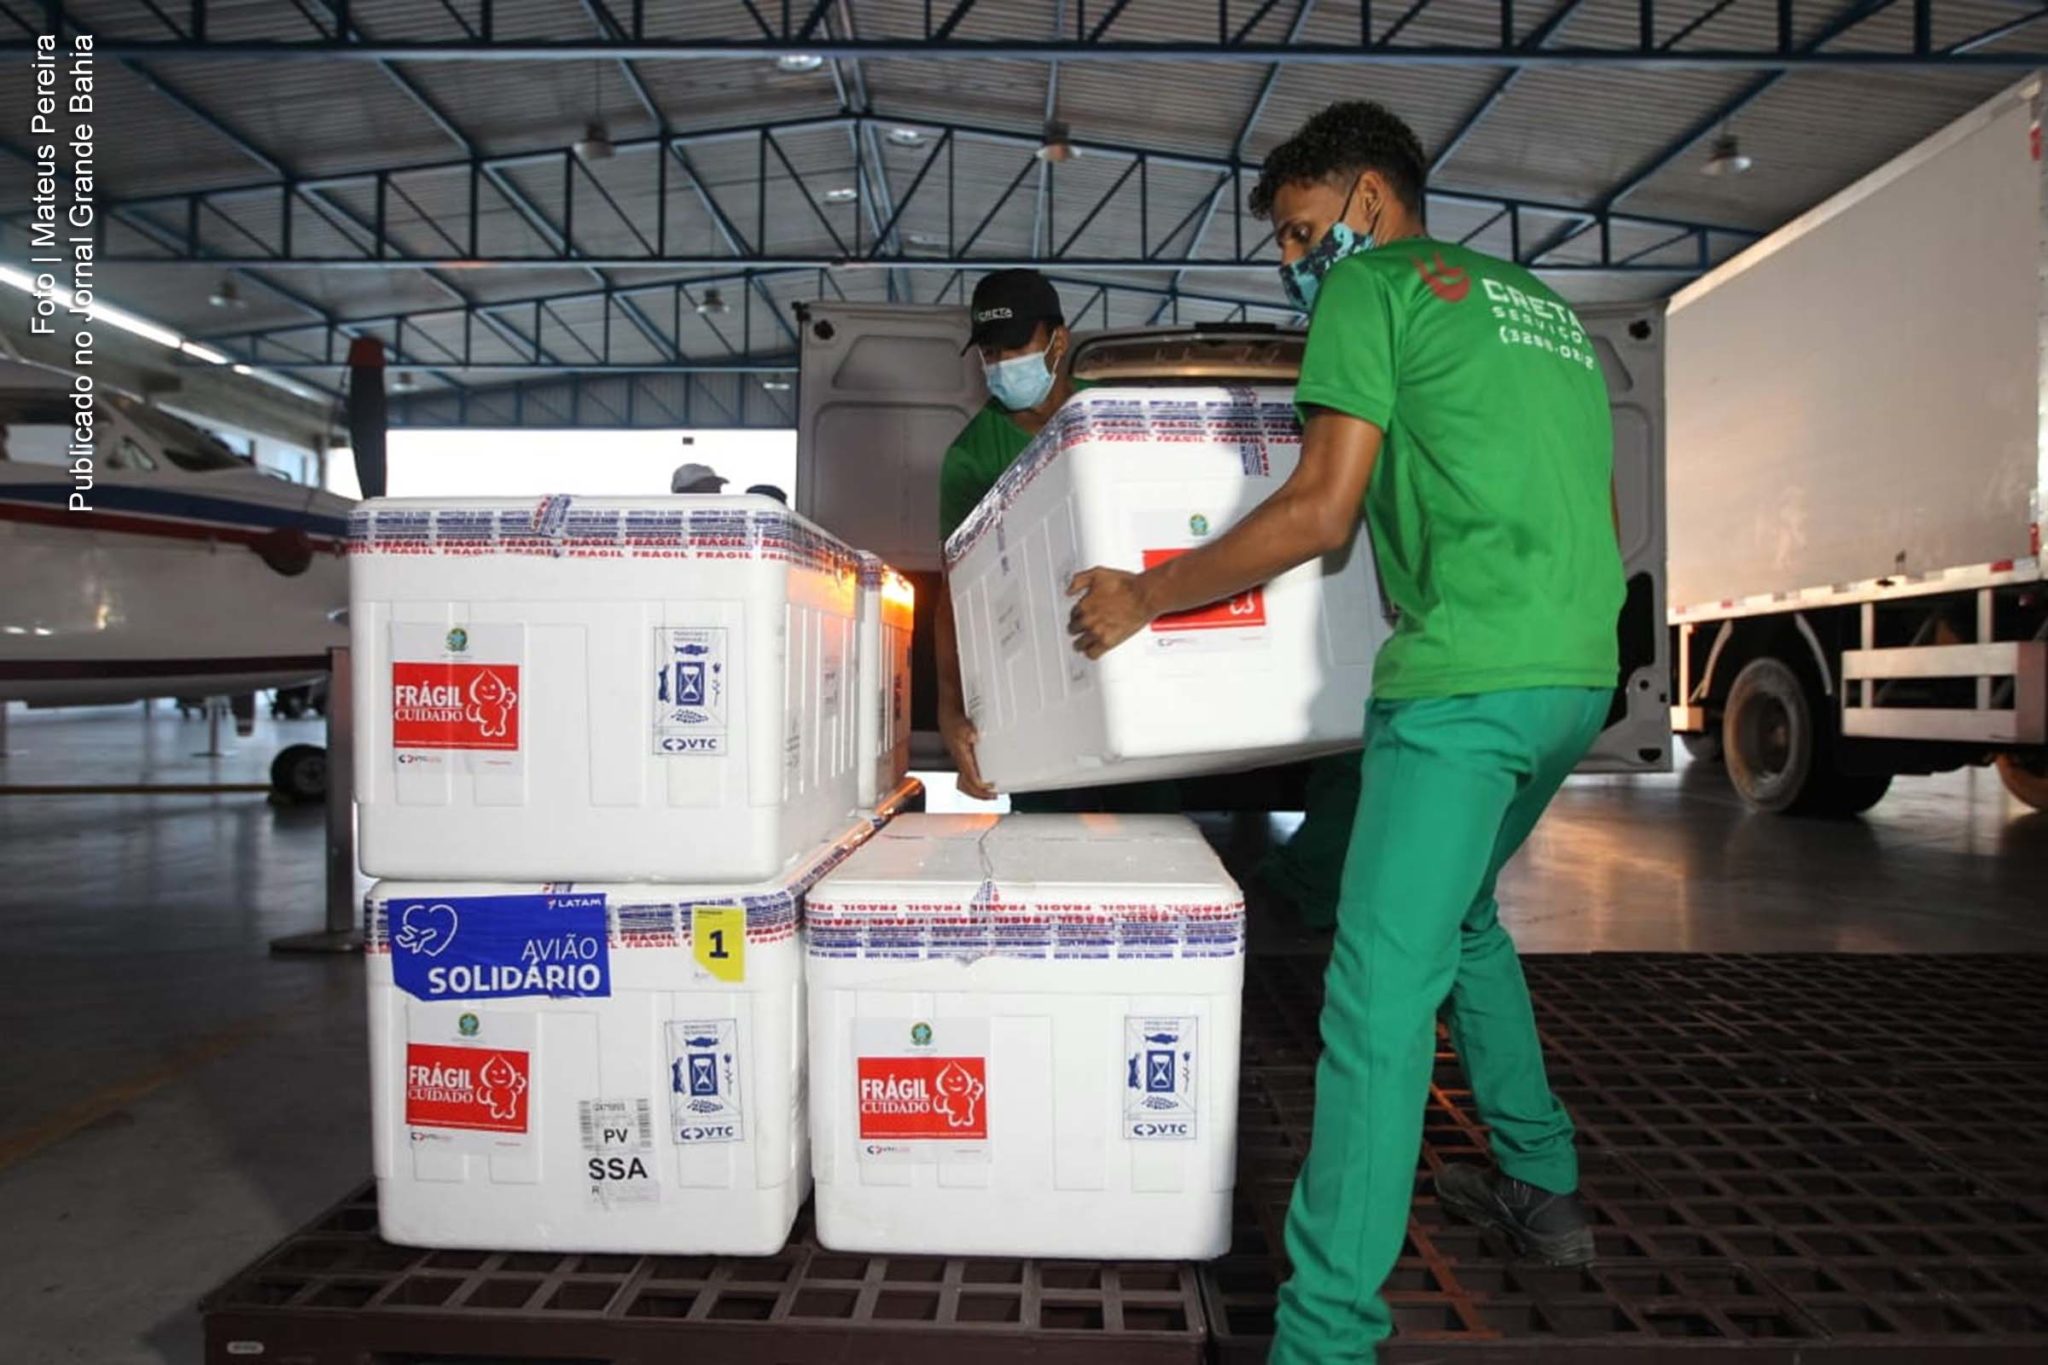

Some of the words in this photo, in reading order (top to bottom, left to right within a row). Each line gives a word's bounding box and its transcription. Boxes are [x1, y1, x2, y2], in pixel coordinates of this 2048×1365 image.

[394, 680, 464, 708] FRÁGIL
[394, 708, 464, 722] CUIDADO
[557, 898, 603, 909] LATAM
[521, 933, 599, 962] AVIÃO
[708, 929, 730, 960] 1
[427, 957, 602, 995] SOLIDÁRIO
[408, 1061, 474, 1091] FRÁGIL
[860, 1073, 931, 1100] FRÁGIL
[407, 1087, 474, 1104] CUIDADO
[861, 1100, 931, 1115] CUIDADO
[603, 1127, 629, 1144] PV
[588, 1156, 649, 1182] SSA
